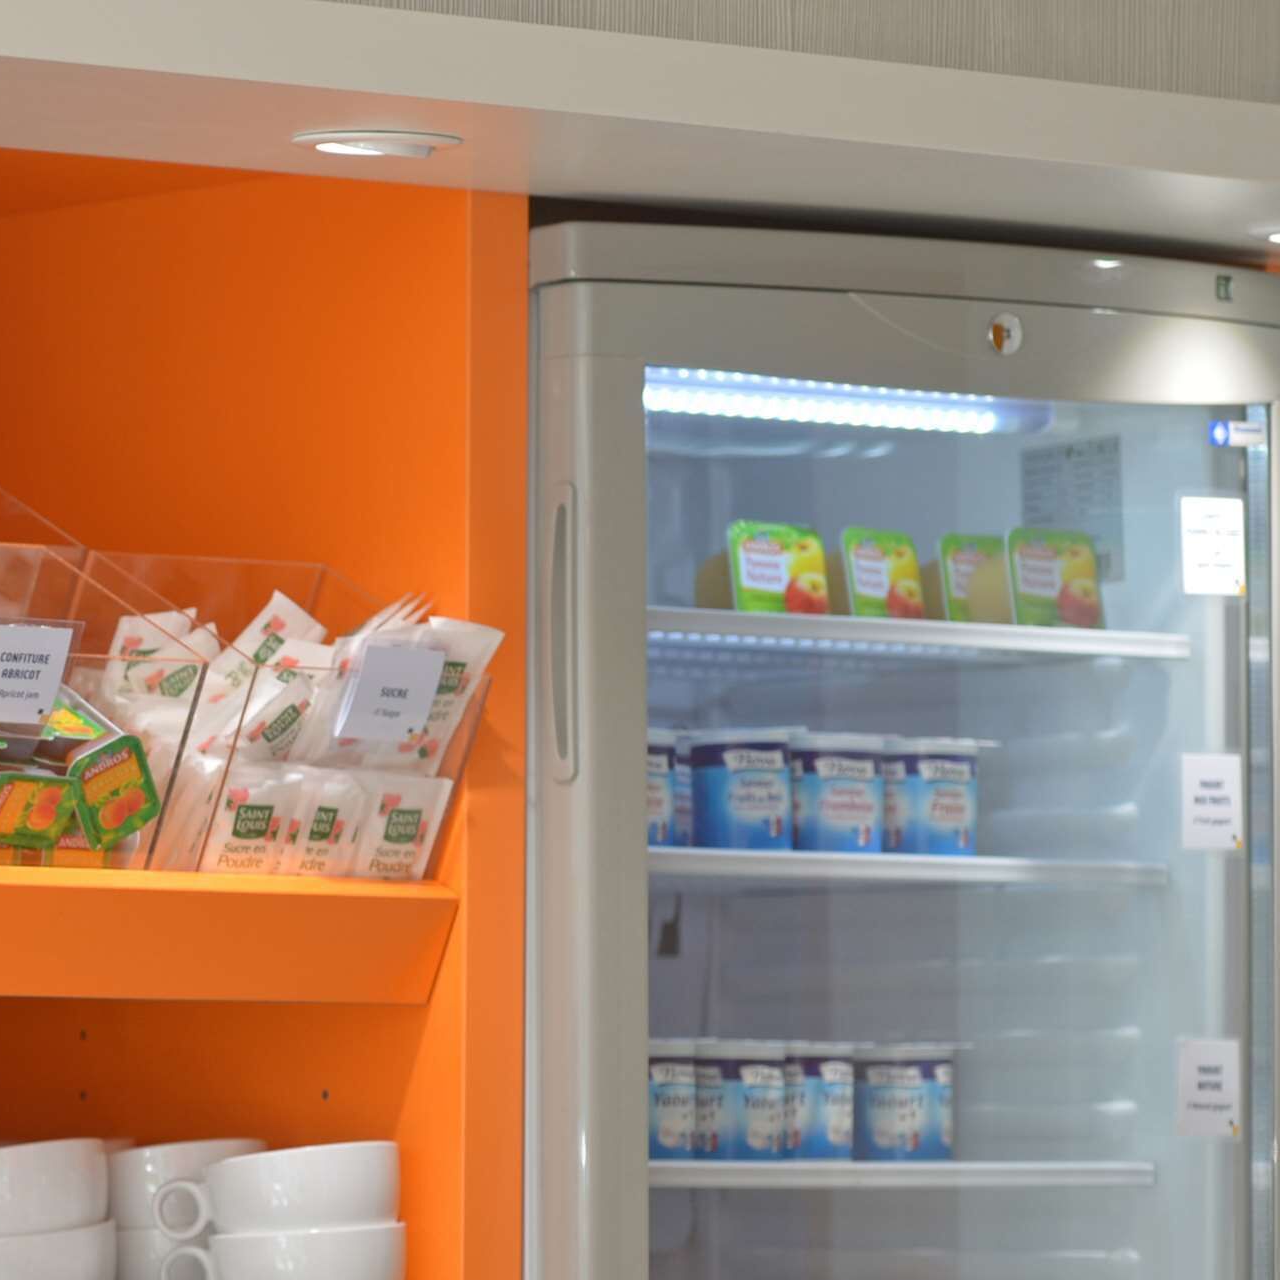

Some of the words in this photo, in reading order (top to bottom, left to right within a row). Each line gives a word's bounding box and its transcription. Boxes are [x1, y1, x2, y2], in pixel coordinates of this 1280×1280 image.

[0, 651, 51, 664] CONFITURE
[1, 668, 41, 680] ABRICOT
[380, 687, 409, 698] SUCRE
[239, 809, 270, 819] SAINT
[390, 811, 420, 822] SAINT
[236, 820, 267, 833] LOUIS
[224, 842, 252, 854] Sucre
[217, 854, 264, 869] Poudre
